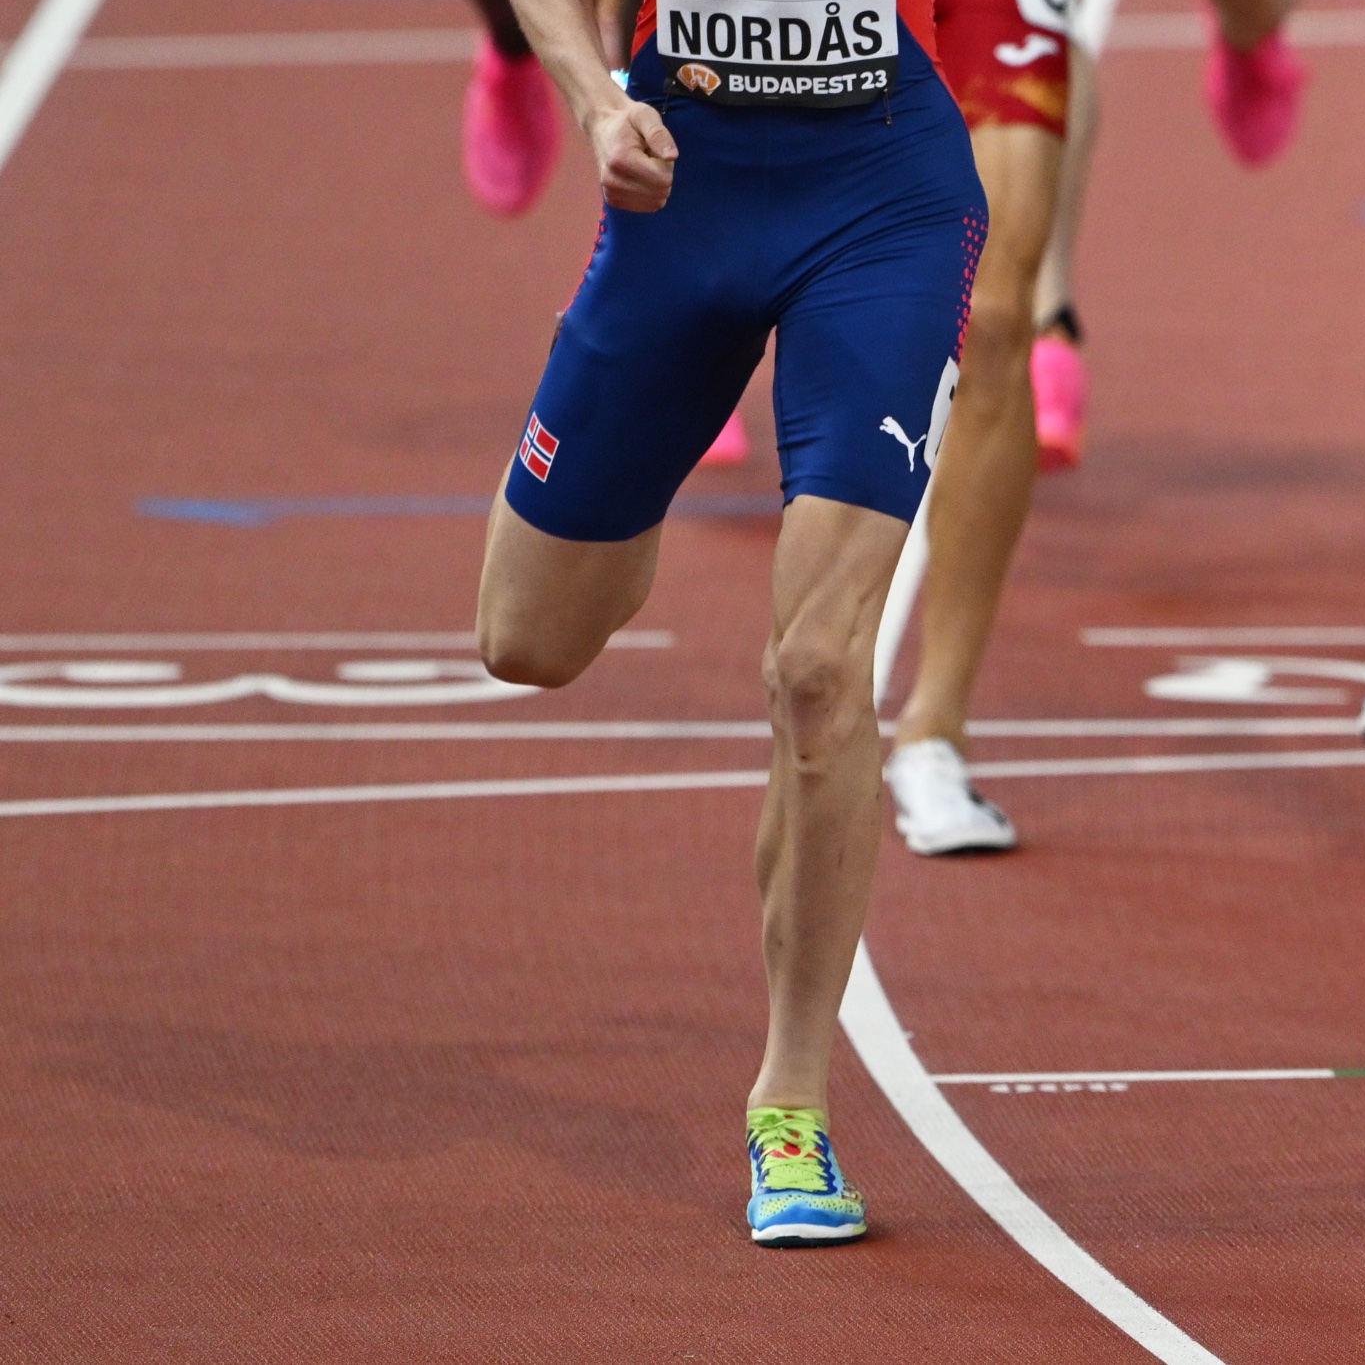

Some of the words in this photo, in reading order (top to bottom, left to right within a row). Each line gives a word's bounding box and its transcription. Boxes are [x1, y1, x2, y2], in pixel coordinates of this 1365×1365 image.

[669, 2, 882, 61] NORDÅS
[729, 73, 857, 95] BUDAPEST
[860, 69, 888, 91] 23
